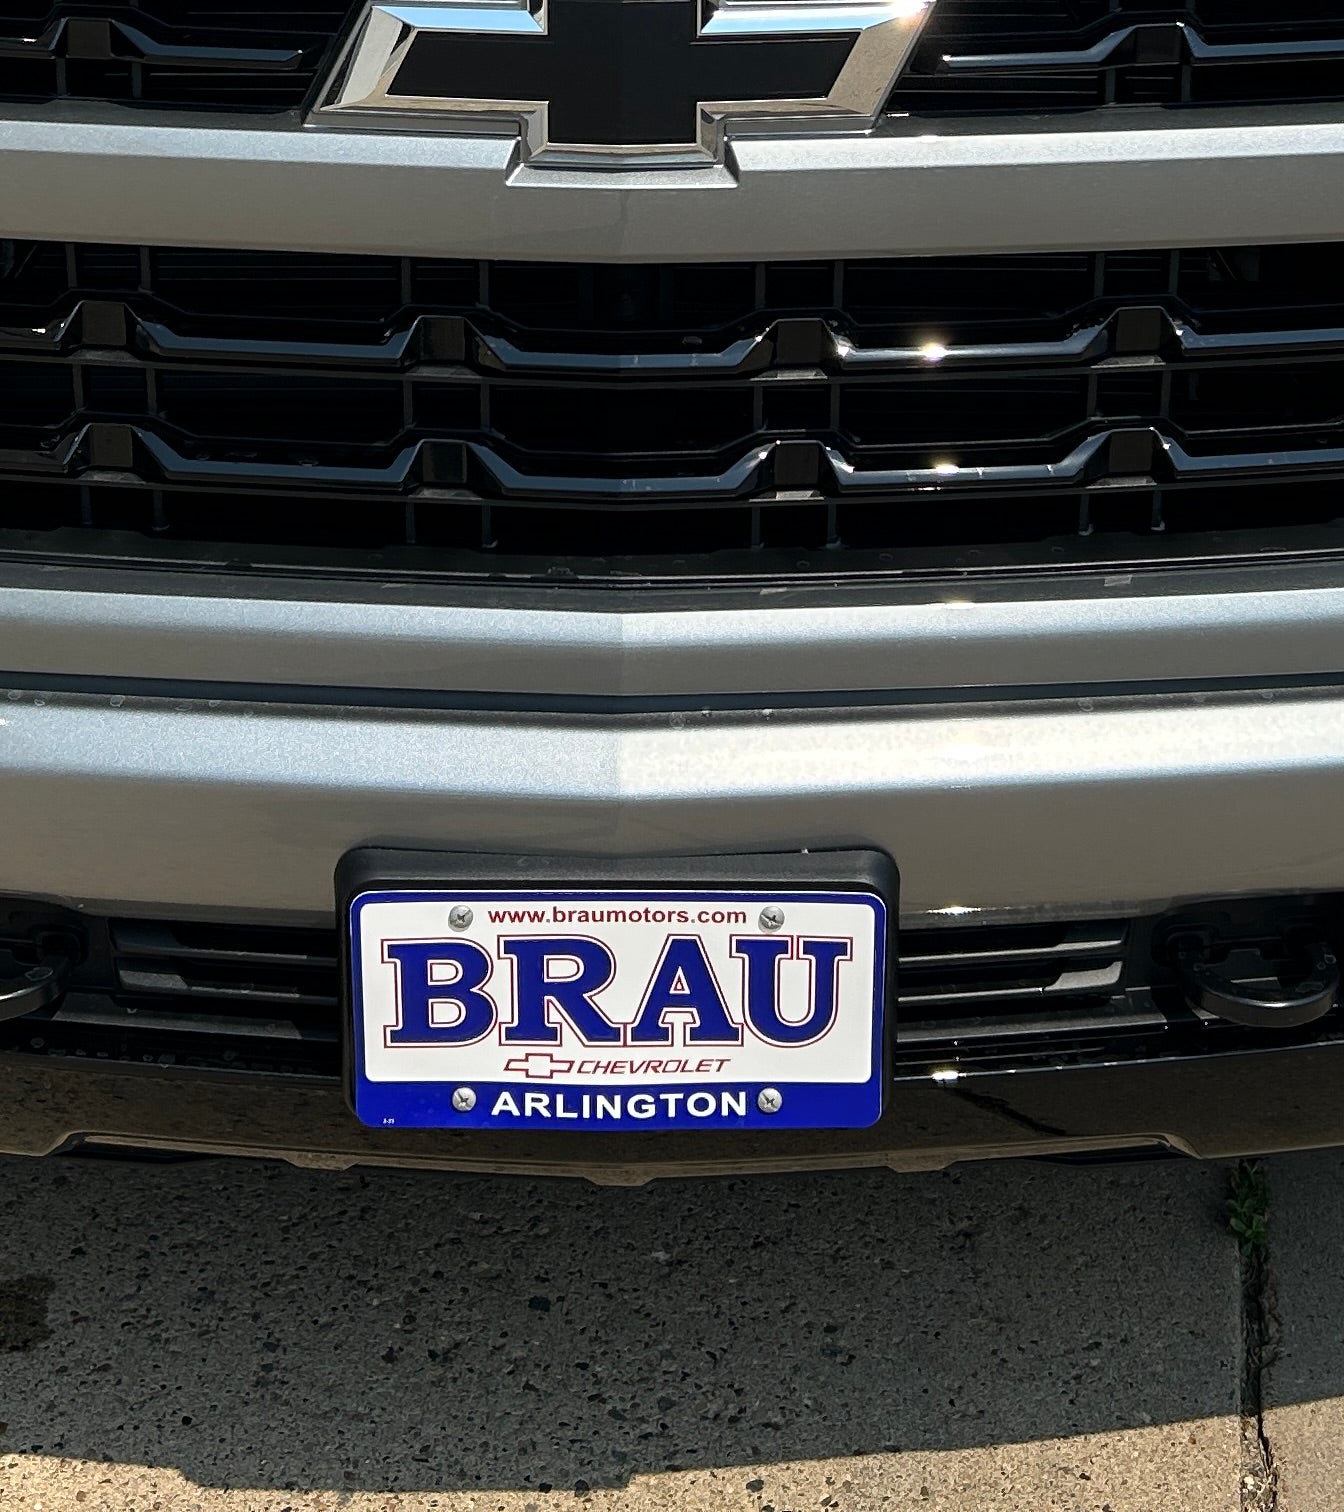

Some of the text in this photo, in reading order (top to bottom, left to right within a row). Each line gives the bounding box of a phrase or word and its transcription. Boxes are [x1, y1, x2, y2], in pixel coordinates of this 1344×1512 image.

[487, 906, 747, 925] www.braumotors.com
[380, 932, 853, 1048] BRAU
[576, 1058, 733, 1075] CHEVROLET
[491, 1090, 748, 1120] ARLINGTON
